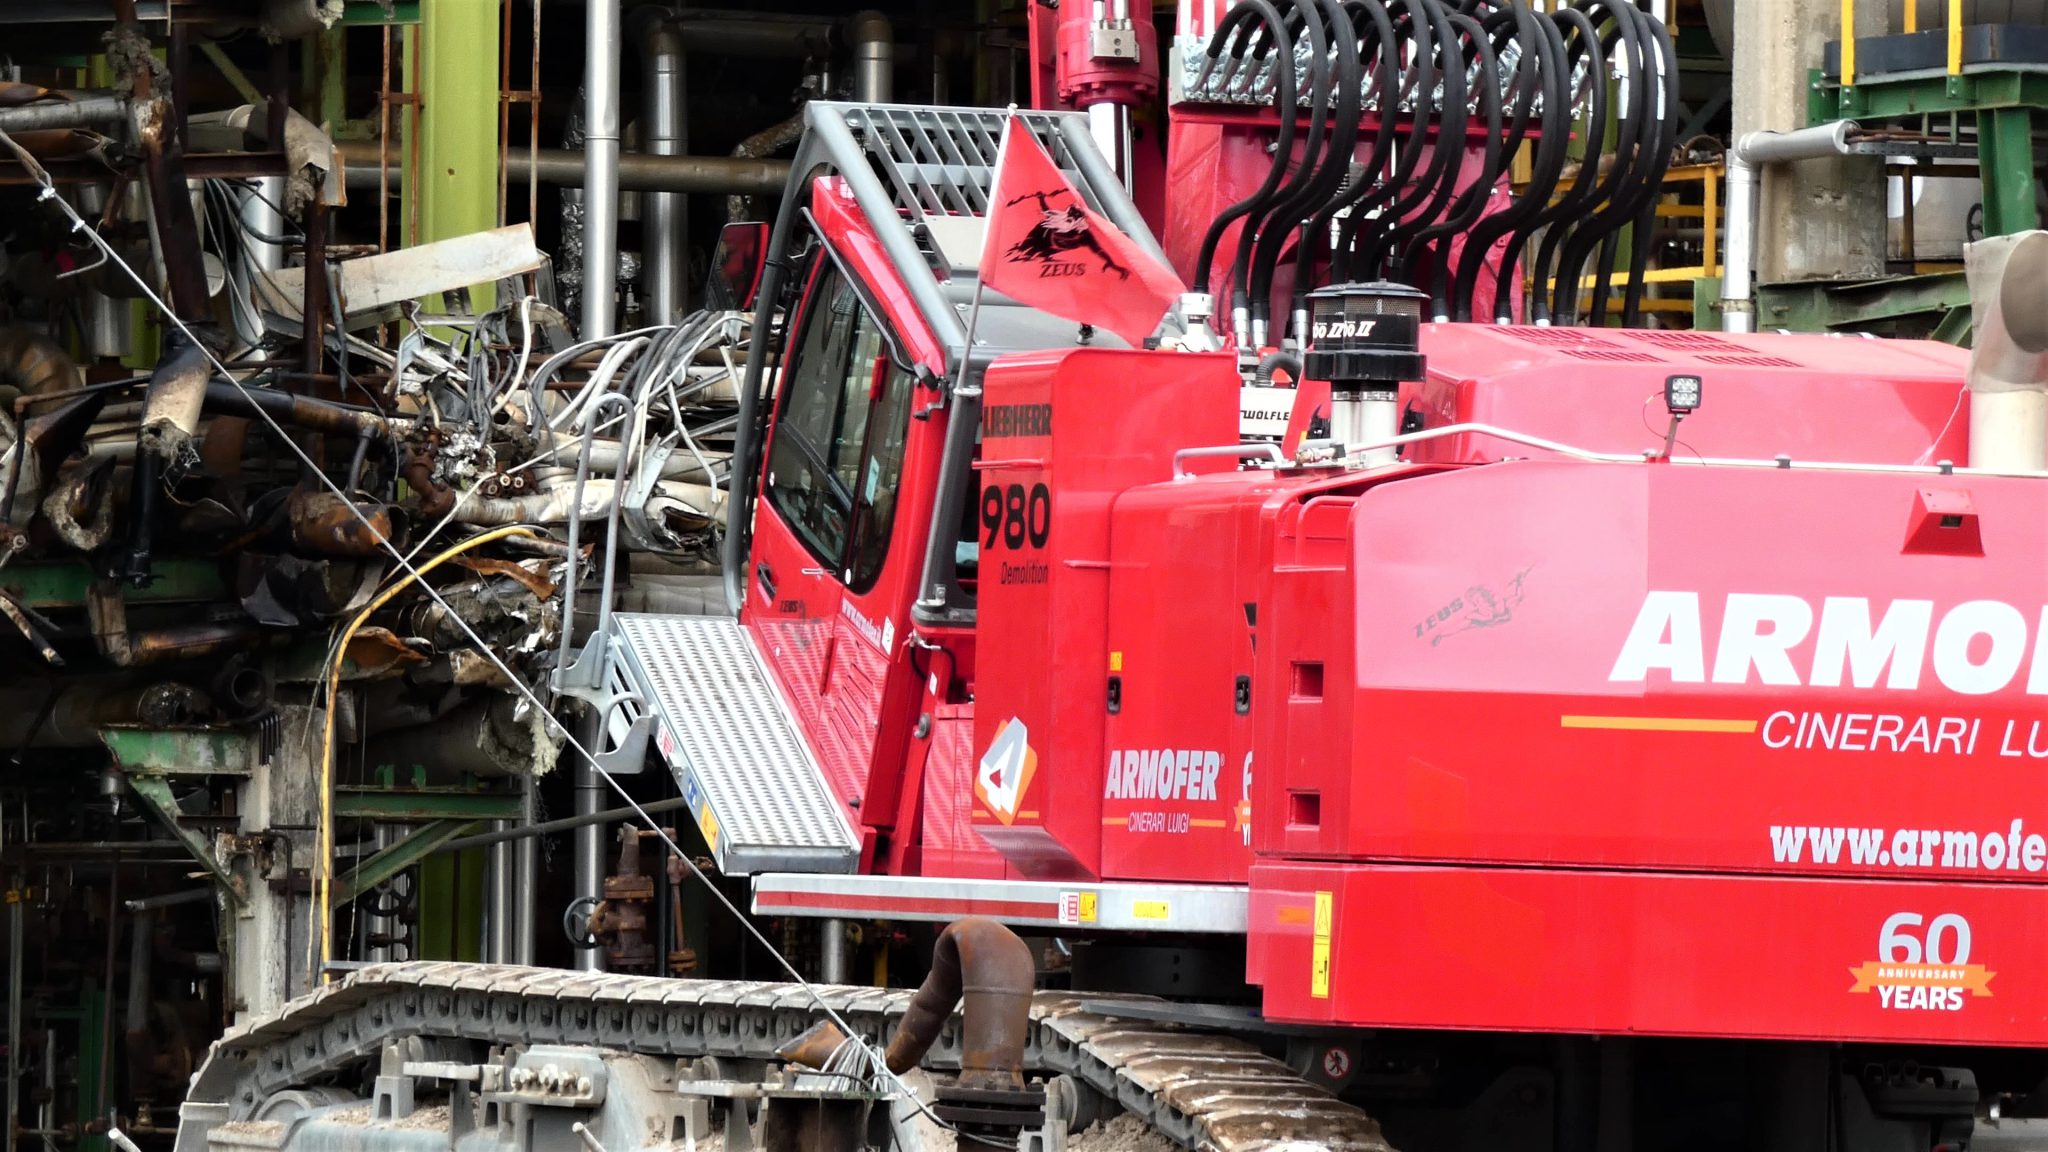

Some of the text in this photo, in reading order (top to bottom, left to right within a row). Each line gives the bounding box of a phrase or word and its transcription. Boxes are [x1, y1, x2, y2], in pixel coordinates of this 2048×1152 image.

[1040, 262, 1087, 278] ZEUS
[983, 404, 1053, 438] LIEBHERR
[981, 482, 1051, 550] 980
[1000, 560, 1049, 586] Demolition
[1415, 597, 1464, 639] ZEUS
[1608, 589, 2048, 695] ARMO
[1762, 710, 1981, 755] CINERARI
[1104, 748, 1220, 801] ARMOFER
[1128, 811, 1190, 833] CINERARI LUIGI
[1770, 818, 2048, 873] www.armofe
[1878, 911, 1971, 966] 60
[1878, 967, 1965, 981] ANNIVERSARY
[1877, 984, 1964, 1011] YEARS
